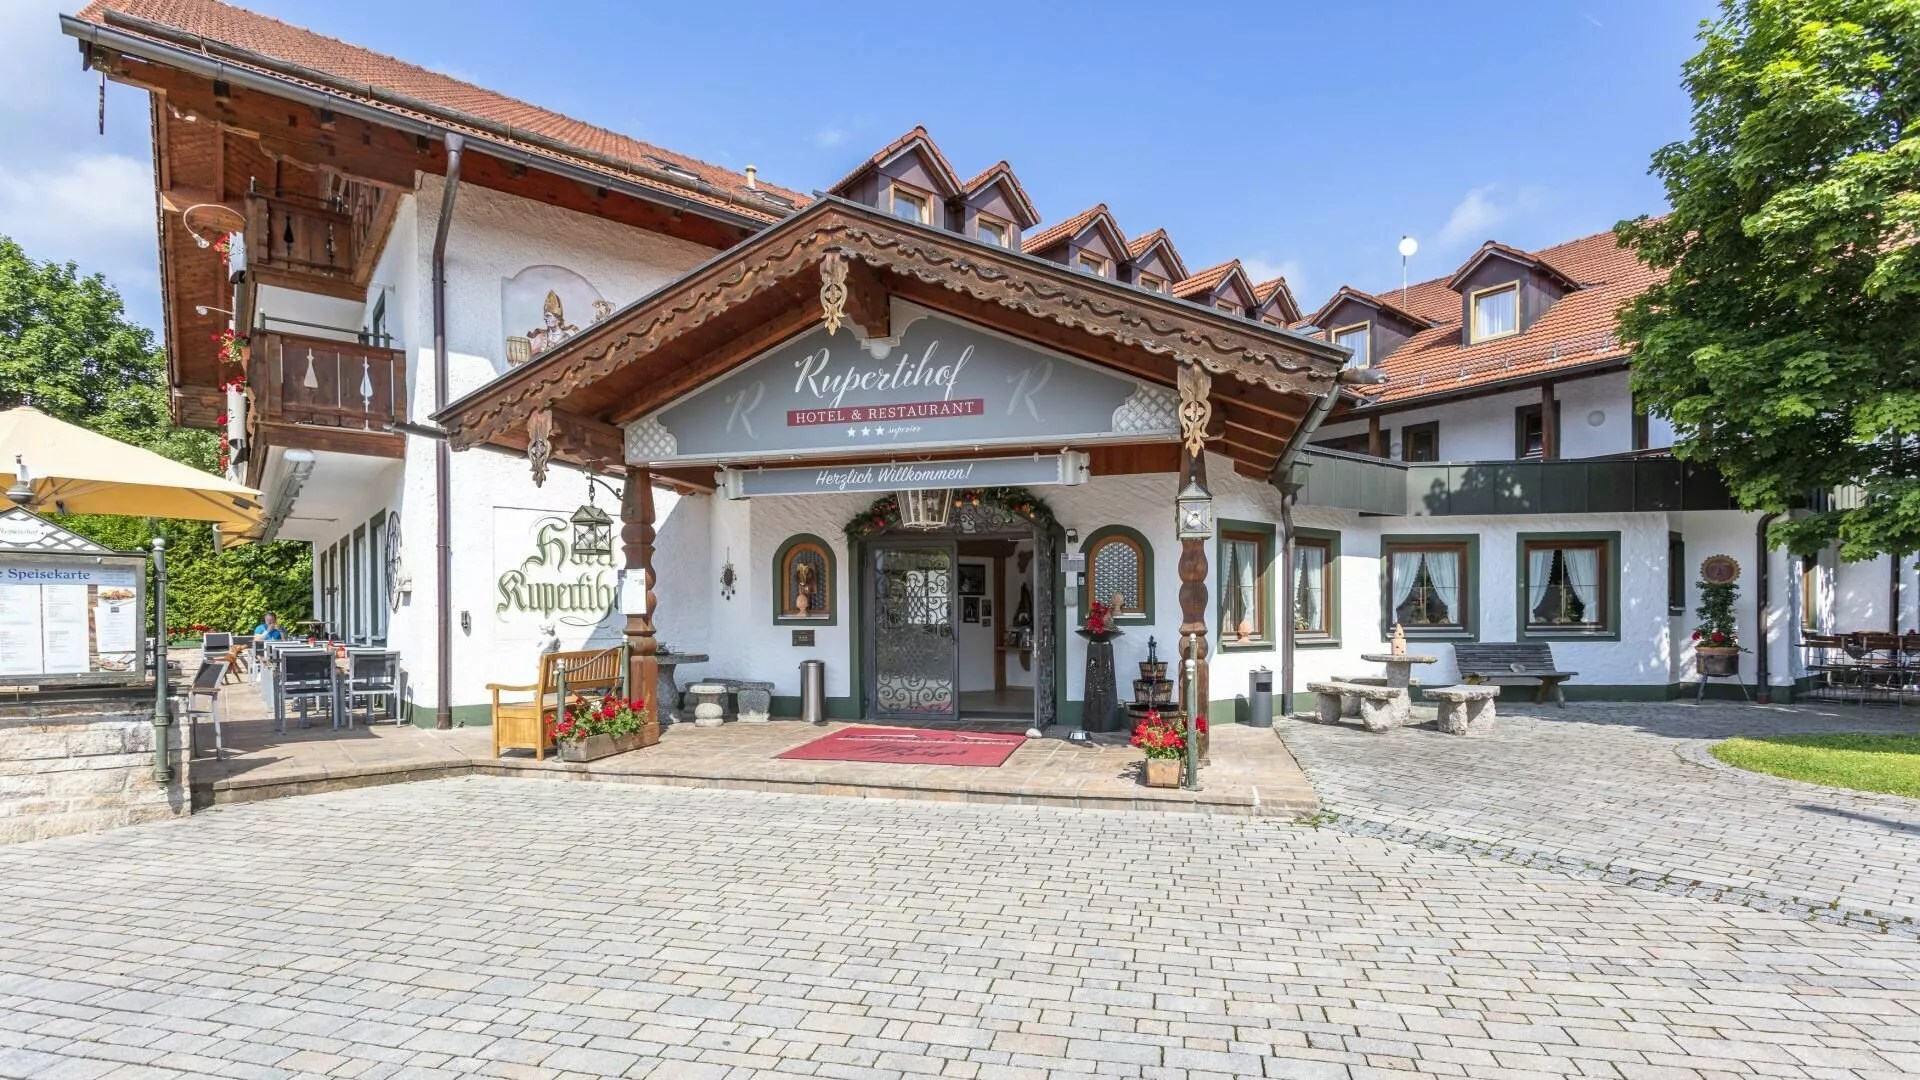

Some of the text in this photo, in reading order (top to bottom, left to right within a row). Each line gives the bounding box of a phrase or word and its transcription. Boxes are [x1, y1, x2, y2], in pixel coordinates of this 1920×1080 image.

[795, 340, 975, 408] Rupertihof
[1006, 360, 1053, 423] R
[725, 381, 765, 439] R
[796, 401, 975, 424] HOTEL & RESTAURANT
[816, 463, 974, 490] Herzlich Willkommen!
[8, 568, 91, 580] Speisekarte
